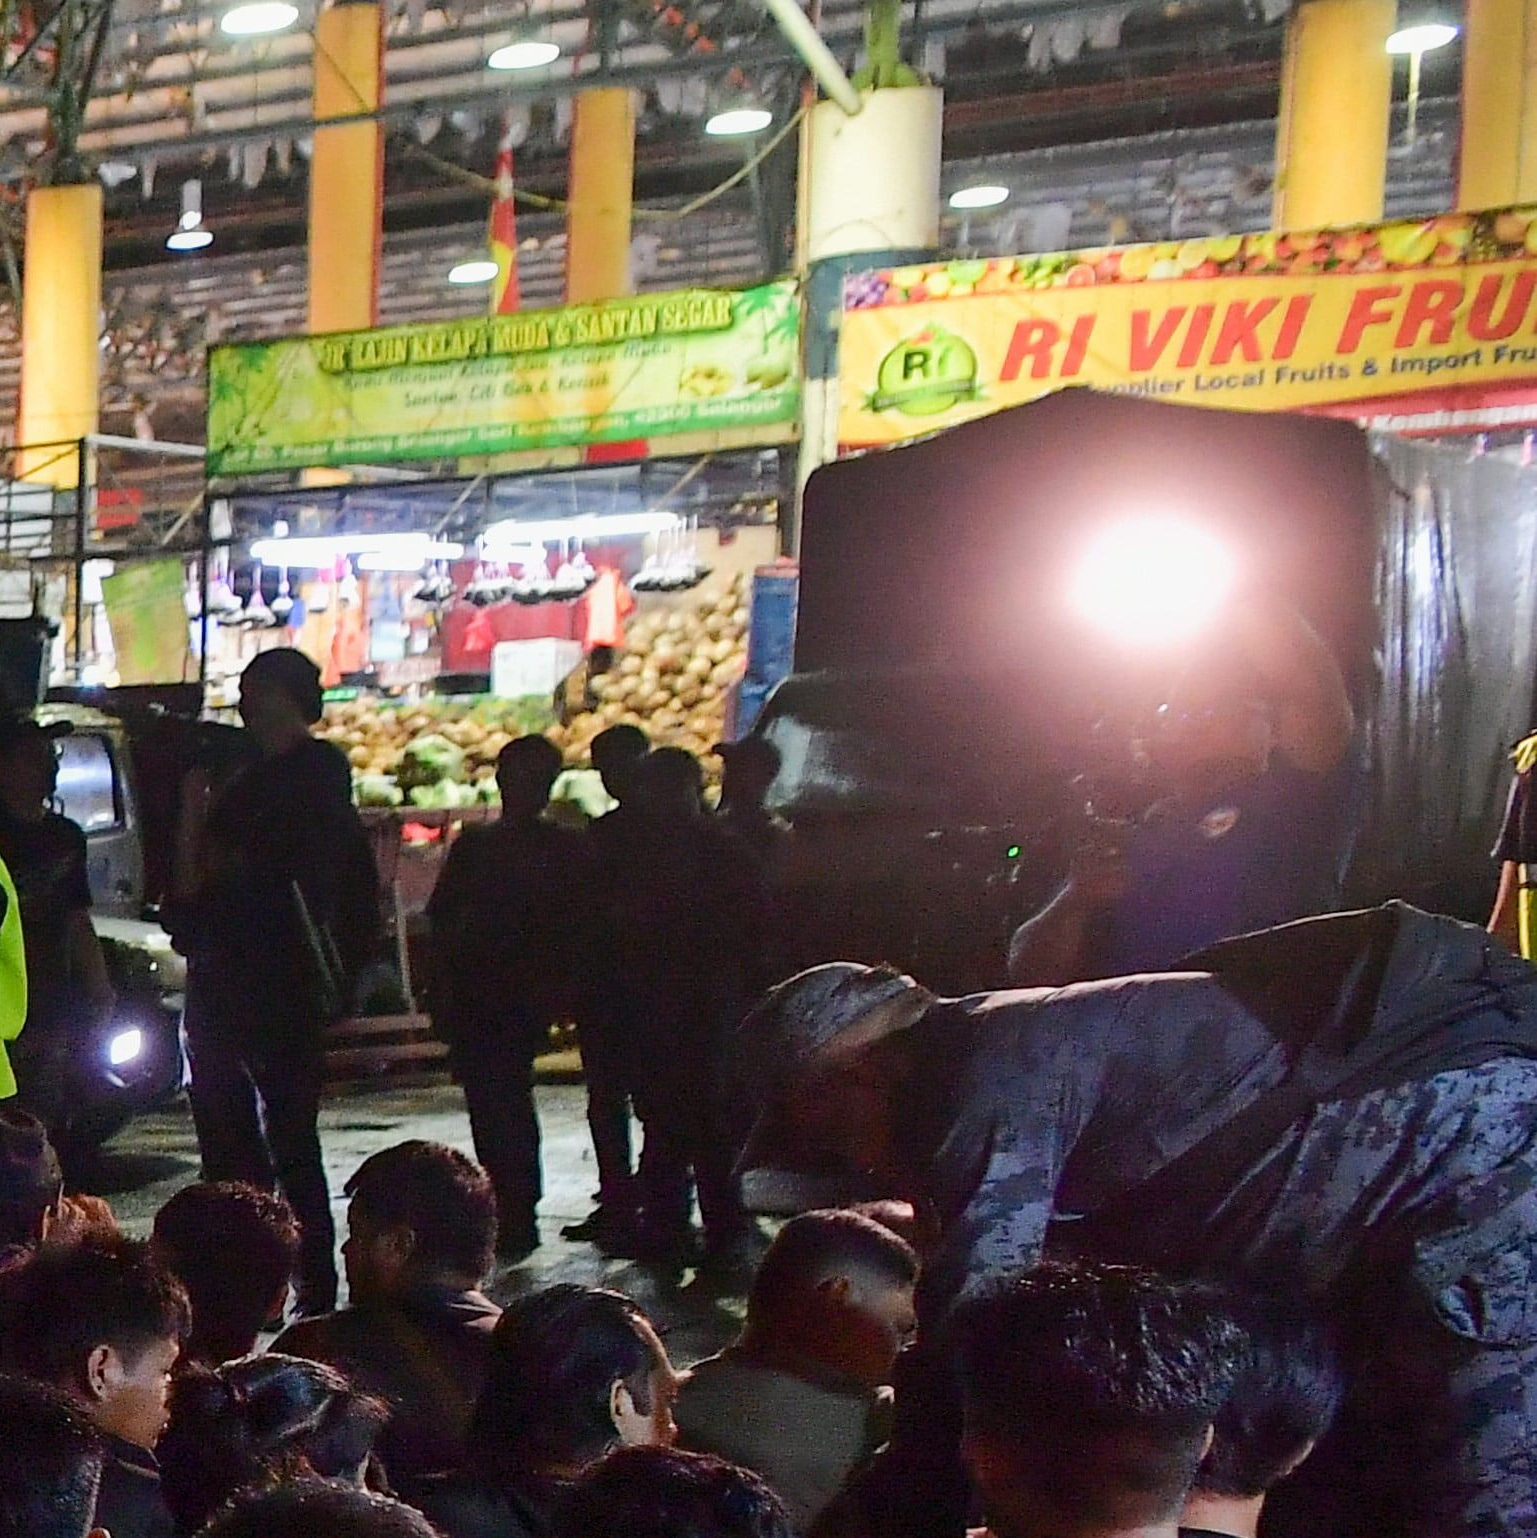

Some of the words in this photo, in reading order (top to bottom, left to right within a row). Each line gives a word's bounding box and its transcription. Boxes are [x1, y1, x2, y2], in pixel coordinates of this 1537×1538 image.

[414, 328, 489, 361] KELAPA
[493, 319, 550, 350] MUDA
[555, 316, 572, 343] &
[577, 305, 659, 342] SANTAN
[662, 296, 733, 329] SEGAR
[999, 314, 1097, 382] RI
[1130, 292, 1314, 372] VIKI
[1336, 269, 1537, 354] FRU
[1195, 368, 1265, 392] Local
[1276, 362, 1350, 384] Fruits
[1362, 359, 1379, 376] &
[1391, 347, 1482, 376] Import
